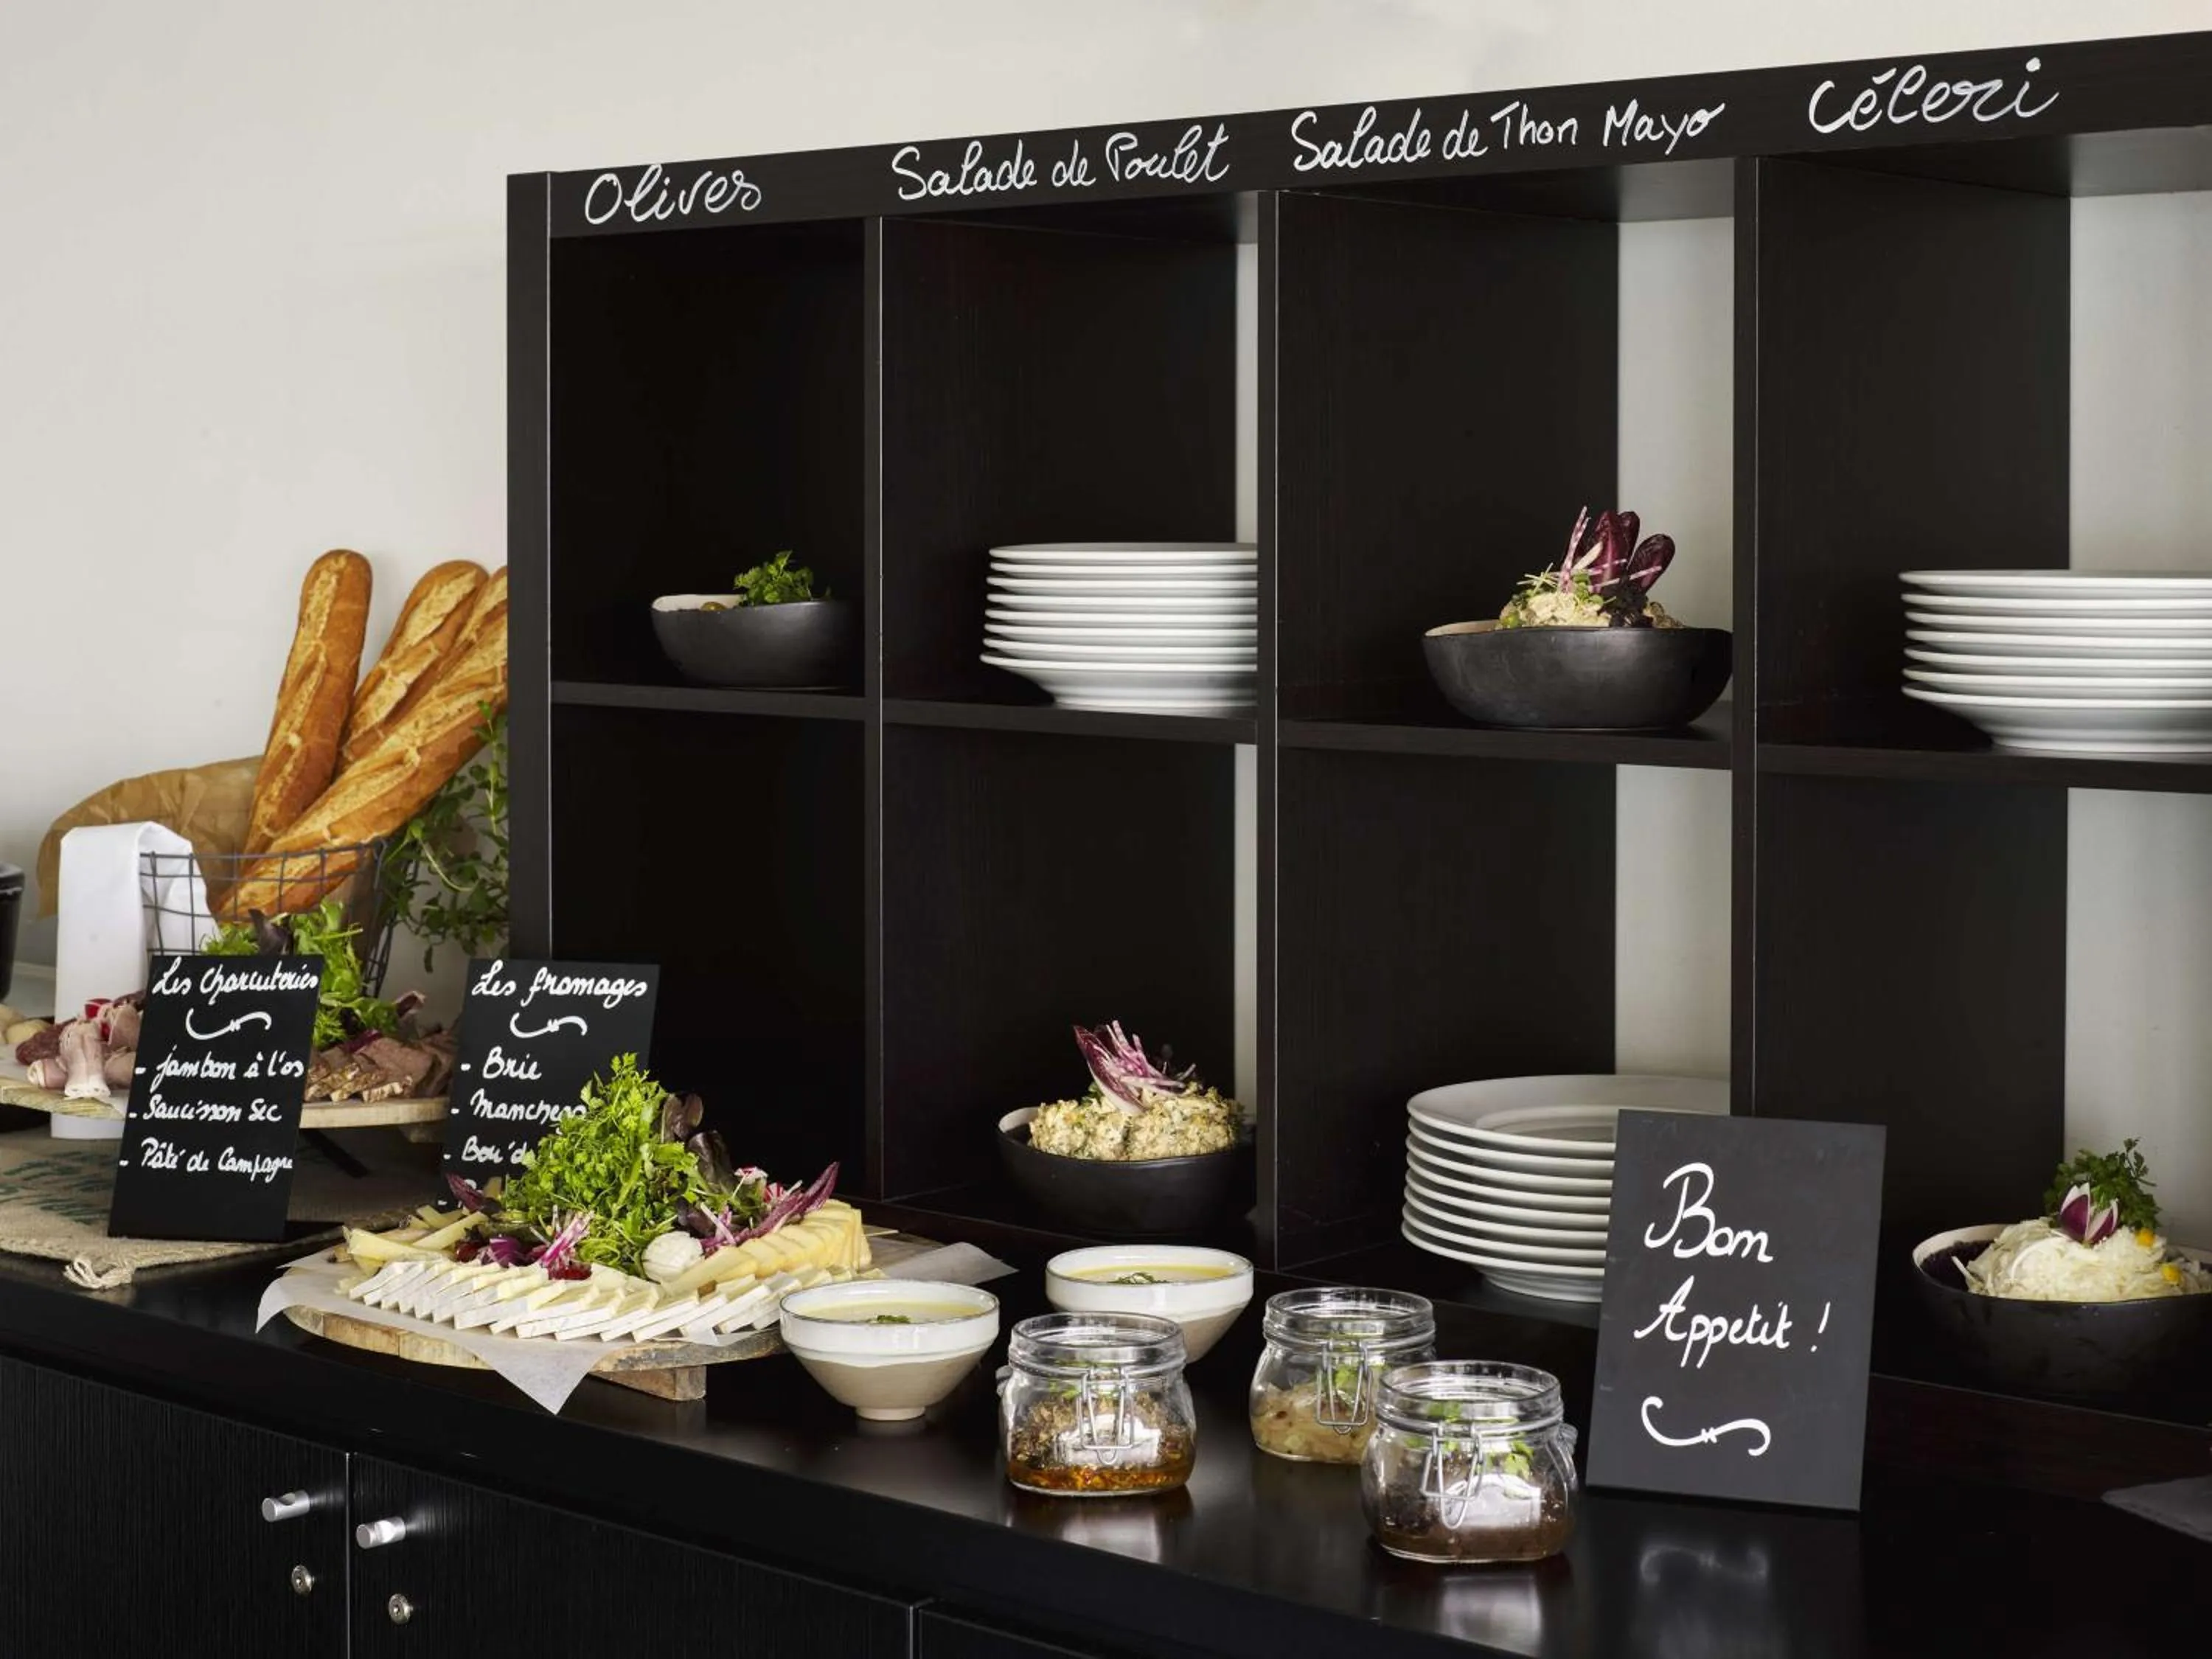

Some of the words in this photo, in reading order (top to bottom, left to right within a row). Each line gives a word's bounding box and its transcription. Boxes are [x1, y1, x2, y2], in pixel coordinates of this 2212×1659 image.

[1291, 105, 1432, 172] Salade
[1442, 108, 1489, 160] de
[1489, 100, 1579, 147] Thon
[1603, 98, 1725, 156] Mayo
[891, 139, 1037, 201] Salade
[1051, 139, 1096, 187] de
[1105, 122, 1230, 184] Poulet
[584, 163, 762, 225] Olives
[152, 956, 192, 995] Les
[471, 960, 517, 996] Les
[267, 1050, 304, 1078] l'os
[482, 1046, 542, 1080] Brie
[142, 1093, 243, 1123] Saucisson
[140, 1136, 185, 1170] Pâté
[186, 1150, 209, 1172] de
[218, 1146, 293, 1183] Campagne
[1644, 1161, 1774, 1263] Bon
[1632, 1274, 1793, 1369] Appetit
